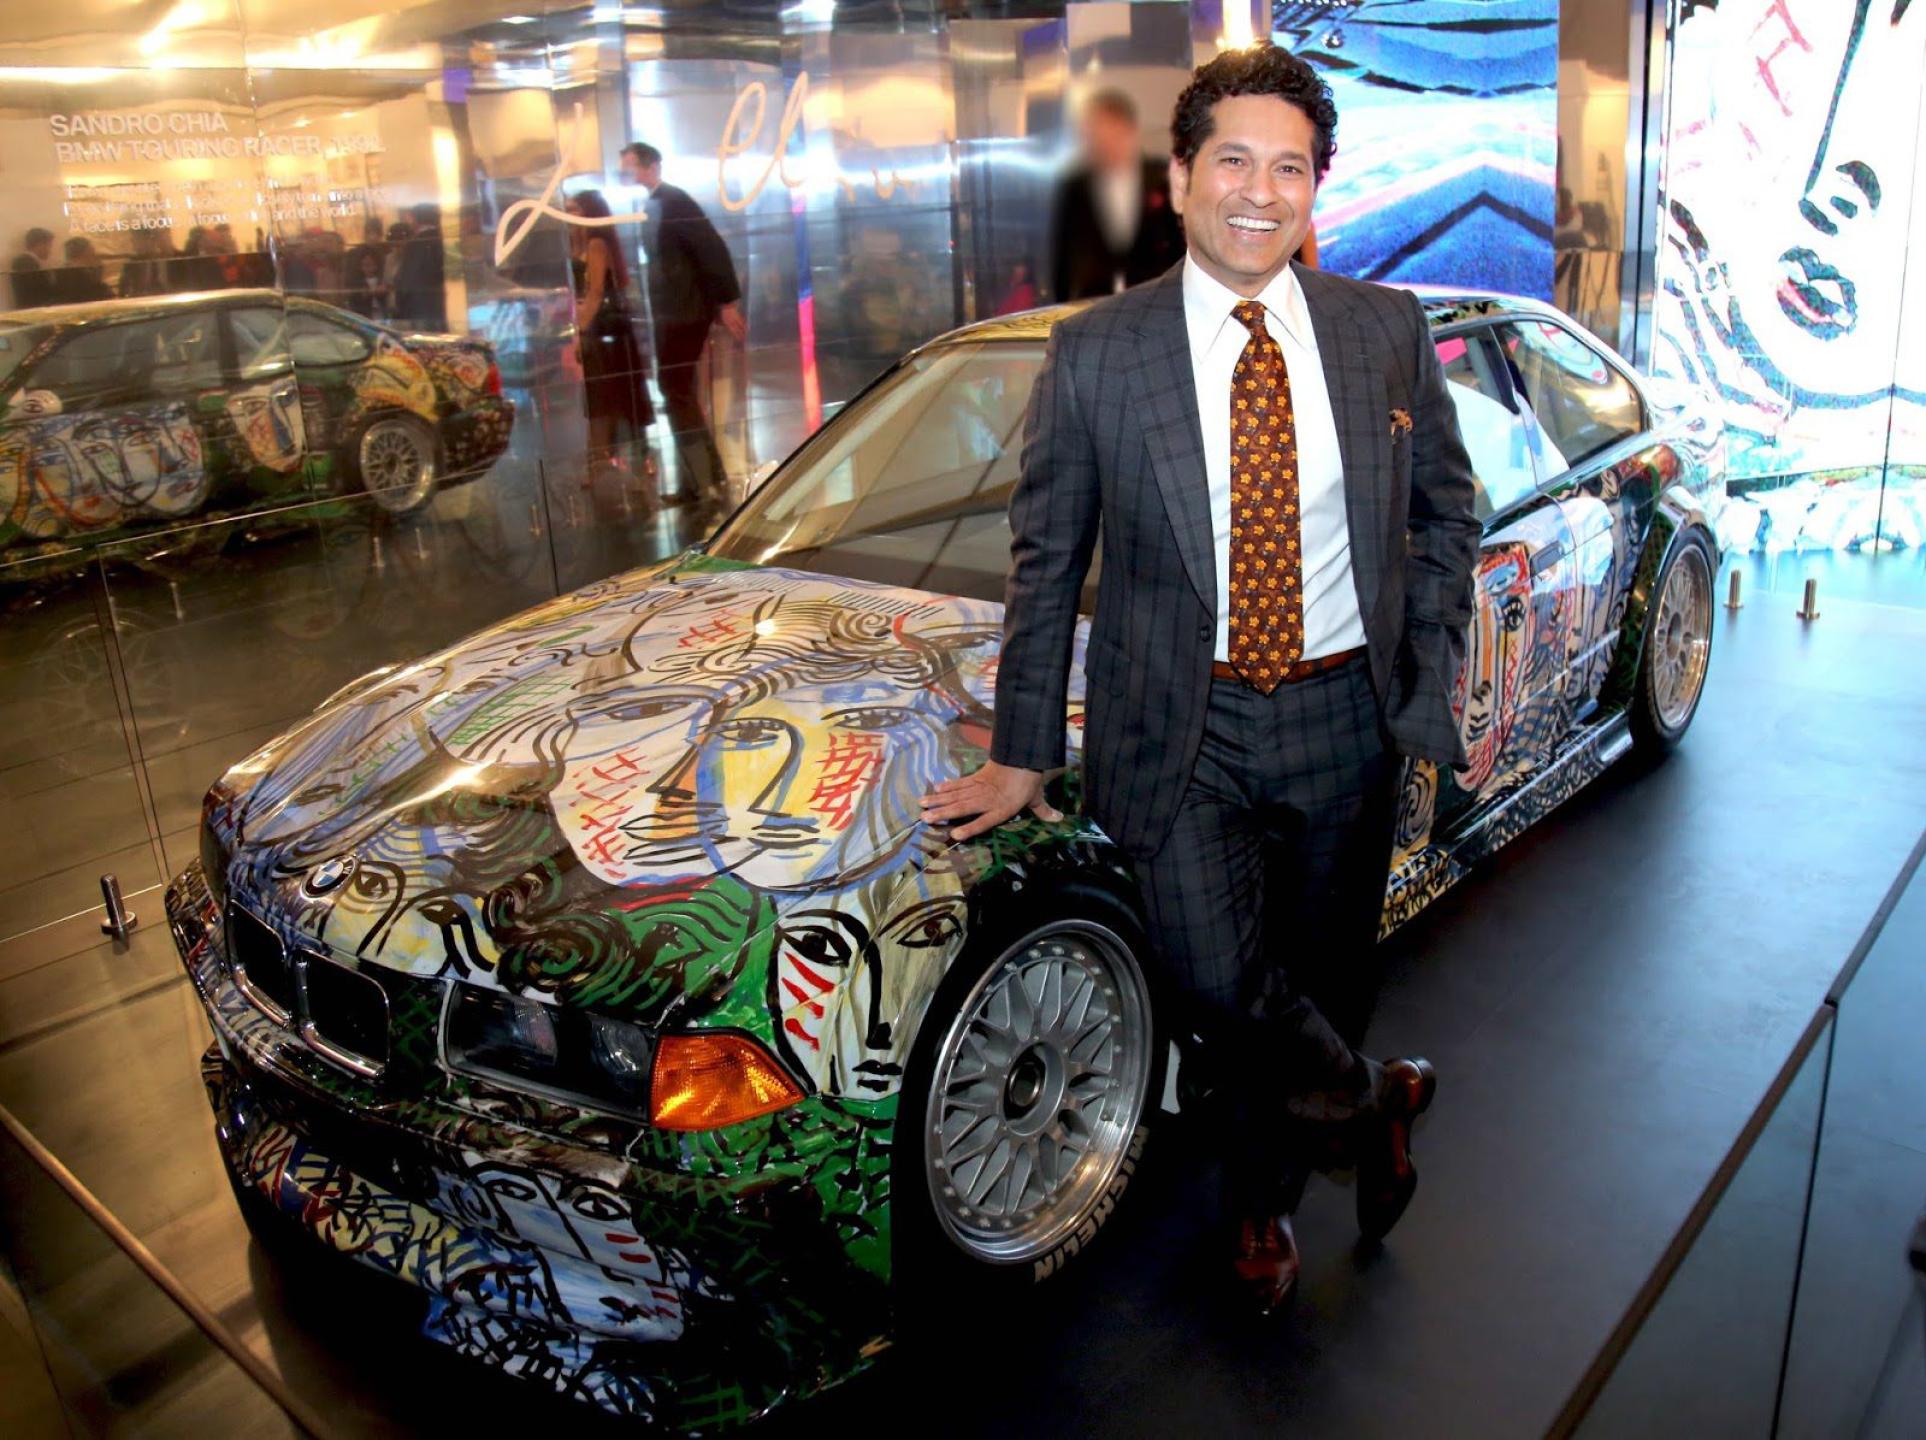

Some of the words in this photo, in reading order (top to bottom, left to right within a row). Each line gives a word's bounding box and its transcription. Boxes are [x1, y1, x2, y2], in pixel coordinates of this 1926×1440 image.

[50, 113, 164, 137] SANDRO
[168, 111, 229, 134] CHIA
[55, 141, 123, 163] BMW
[126, 137, 240, 161] TOURING
[1034, 1124, 1150, 1284] MICHELIN
